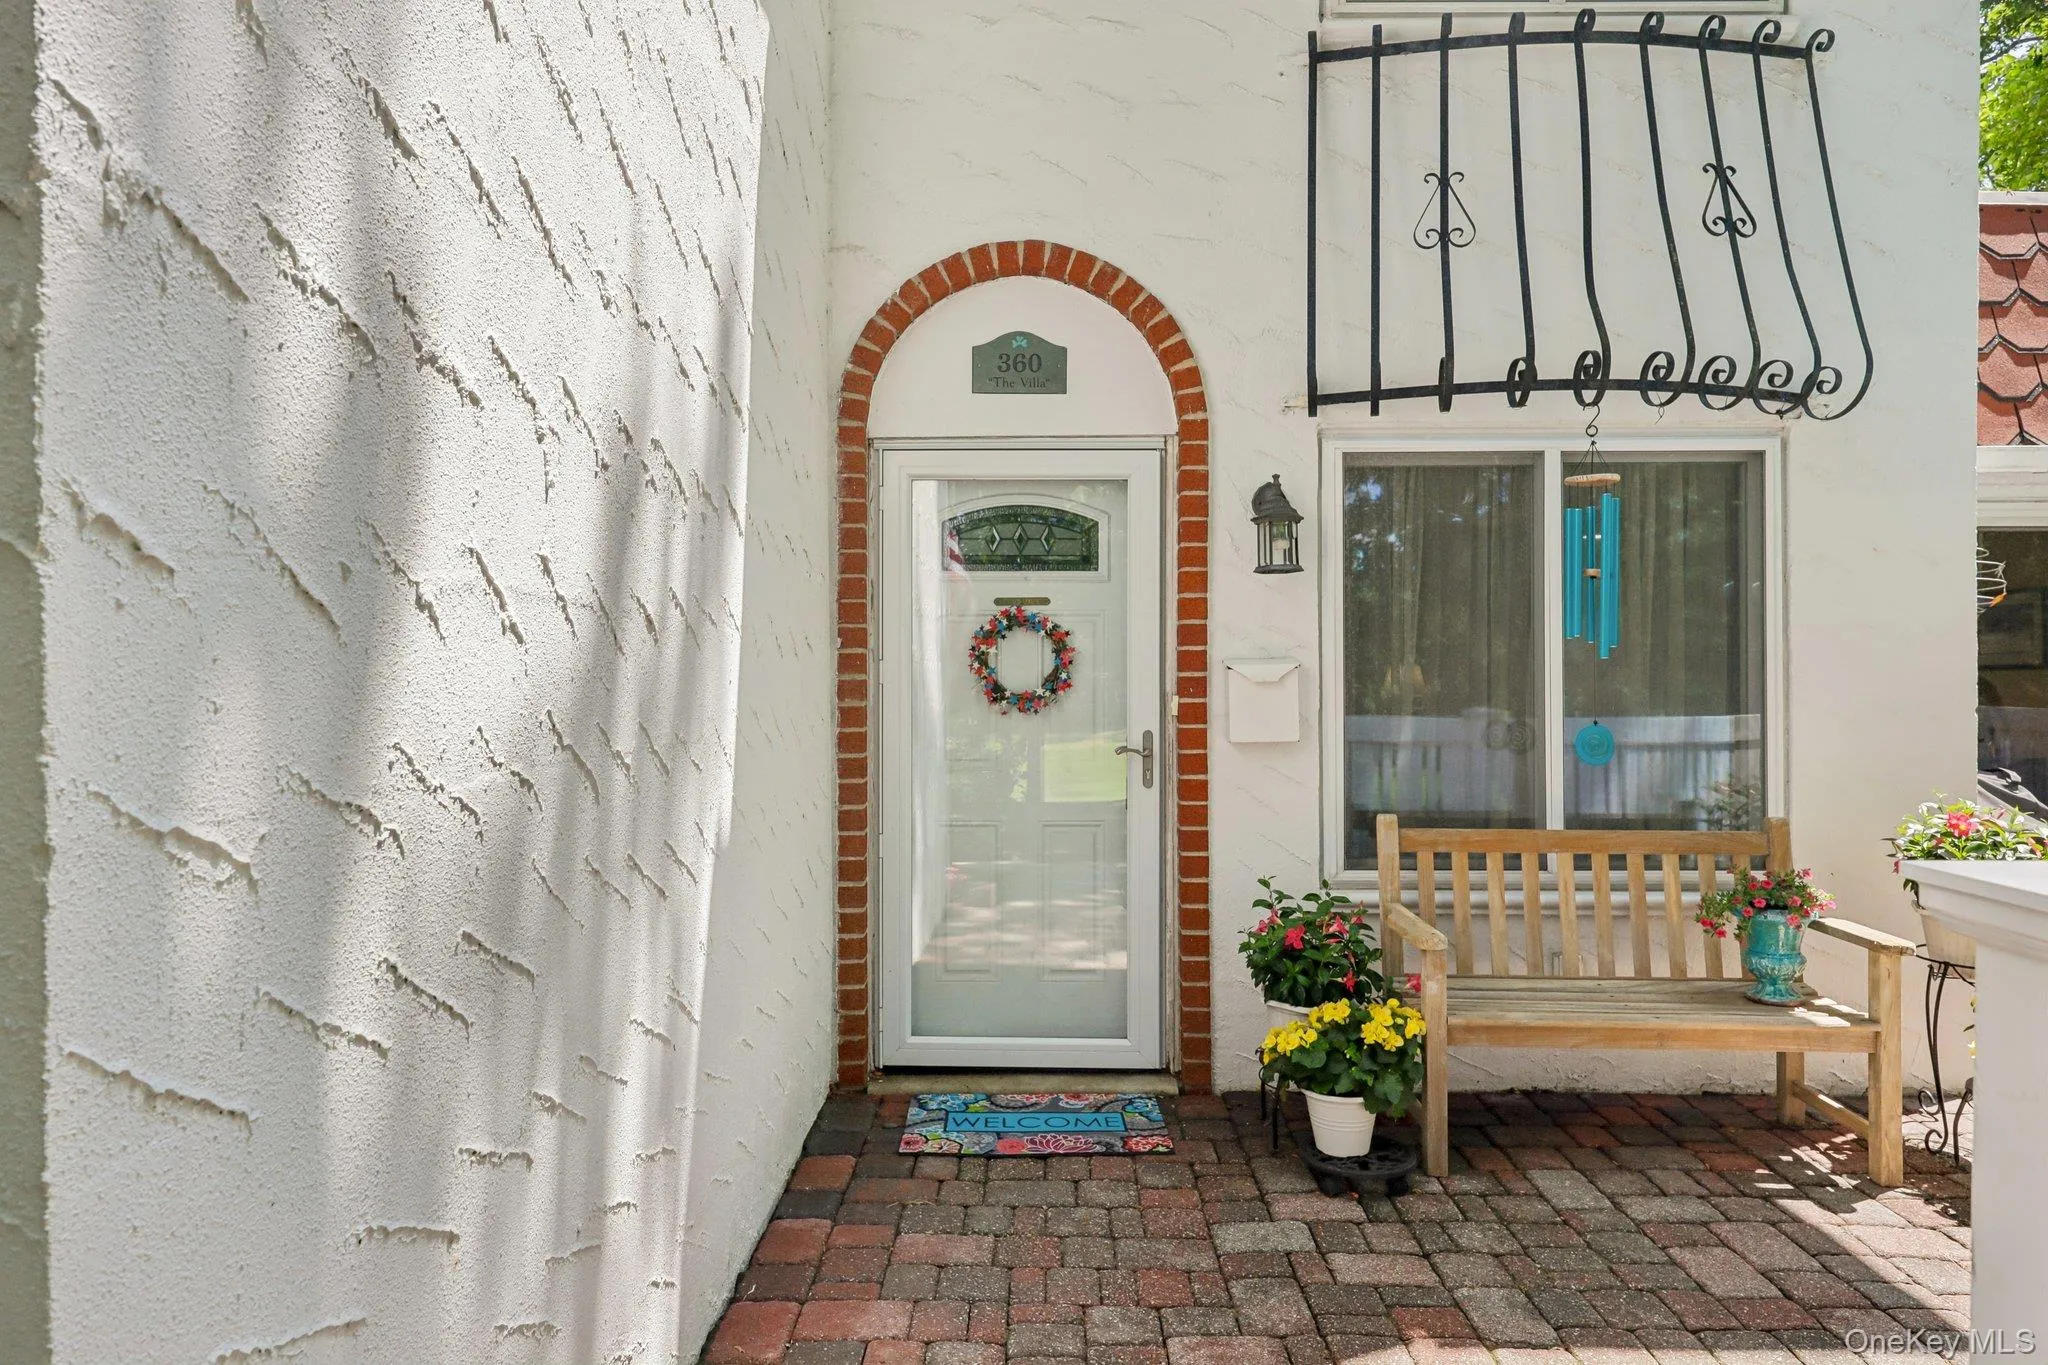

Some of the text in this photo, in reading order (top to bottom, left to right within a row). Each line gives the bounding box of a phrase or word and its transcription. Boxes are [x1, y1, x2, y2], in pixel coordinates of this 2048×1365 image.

[997, 353, 1042, 373] 360
[988, 376, 1050, 388] "The Villa"
[951, 1115, 1121, 1129] WELCOME
